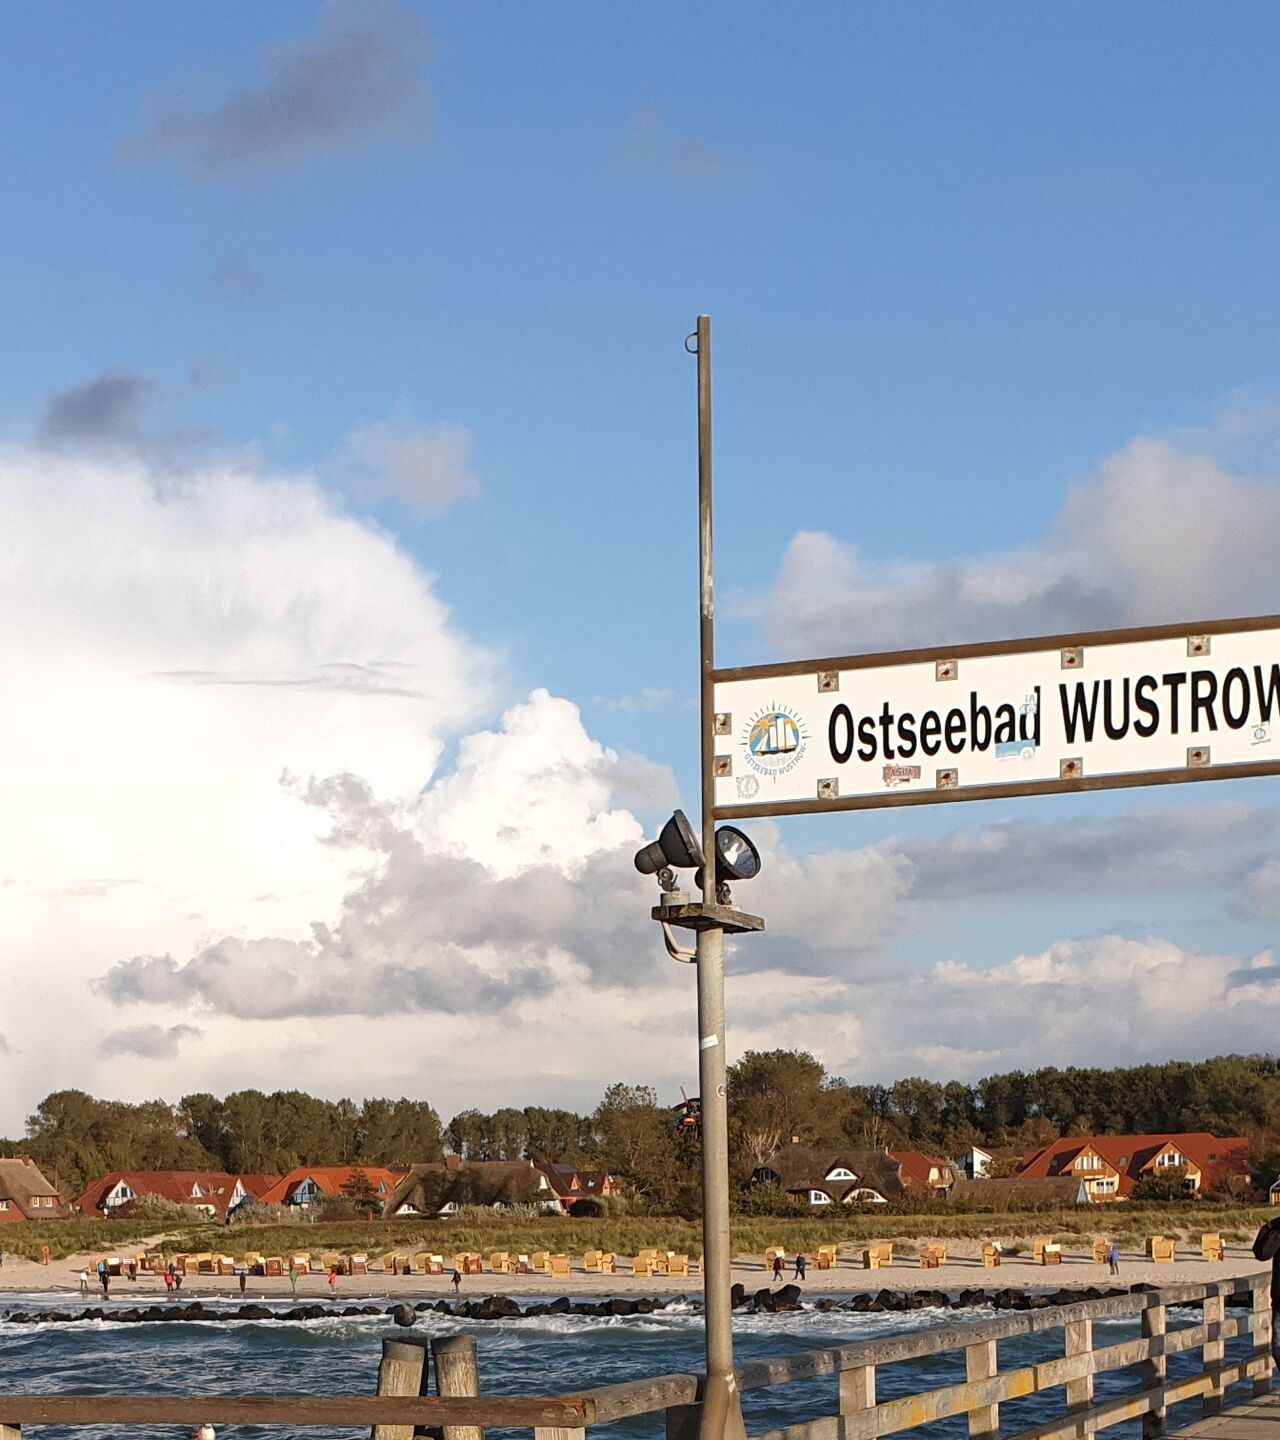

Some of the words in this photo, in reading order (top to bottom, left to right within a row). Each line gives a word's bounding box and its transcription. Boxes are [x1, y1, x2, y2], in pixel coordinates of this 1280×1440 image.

[828, 685, 1041, 764] Ostseebad
[744, 753, 778, 776] OSTSEEBAD
[779, 746, 807, 776] WUSTROW
